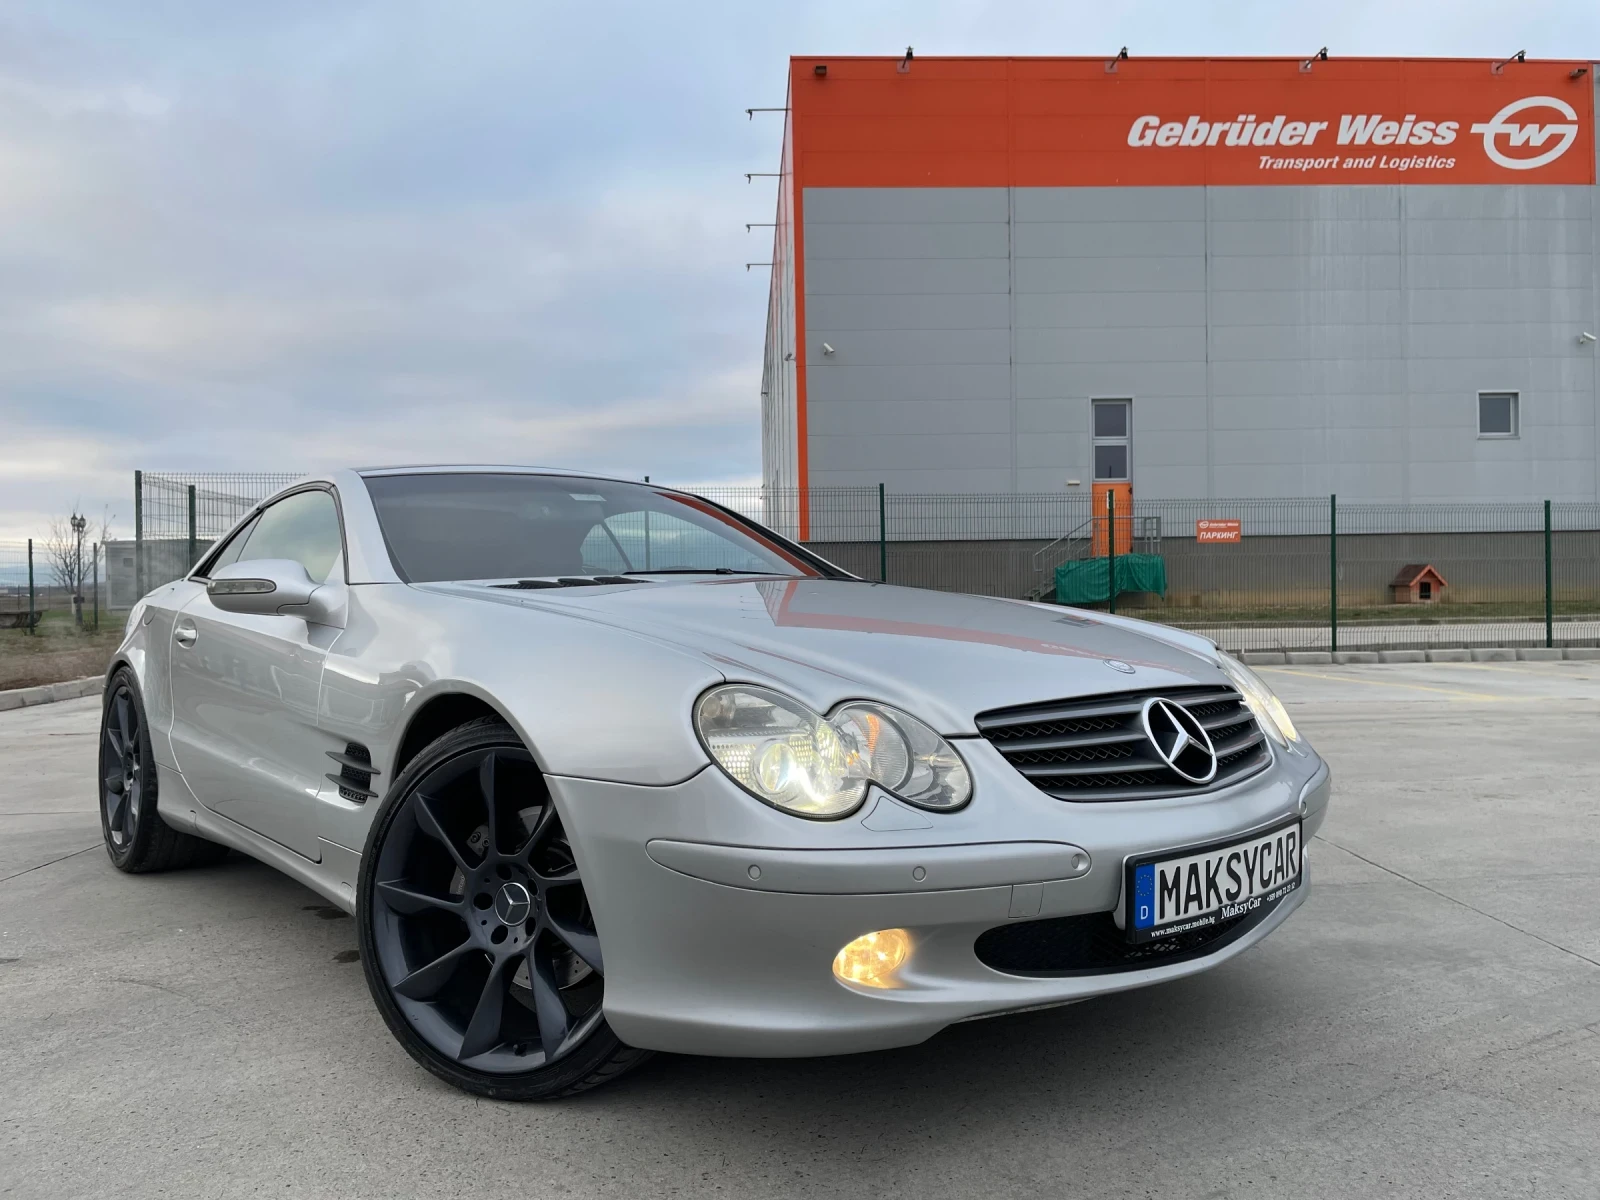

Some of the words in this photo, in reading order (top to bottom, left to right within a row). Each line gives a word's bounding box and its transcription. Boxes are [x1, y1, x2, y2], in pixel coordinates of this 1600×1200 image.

[1127, 114, 1328, 148] Gebrüder
[1336, 114, 1459, 146] Weiss
[1258, 155, 1340, 171] Transport
[1342, 155, 1377, 169] and
[1379, 155, 1456, 171] Logistics
[1200, 531, 1239, 540] ПАРКИНГ
[1140, 905, 1149, 920] D
[1159, 831, 1297, 920] MAKSYCAR
[1220, 897, 1262, 920] MaksyCar
